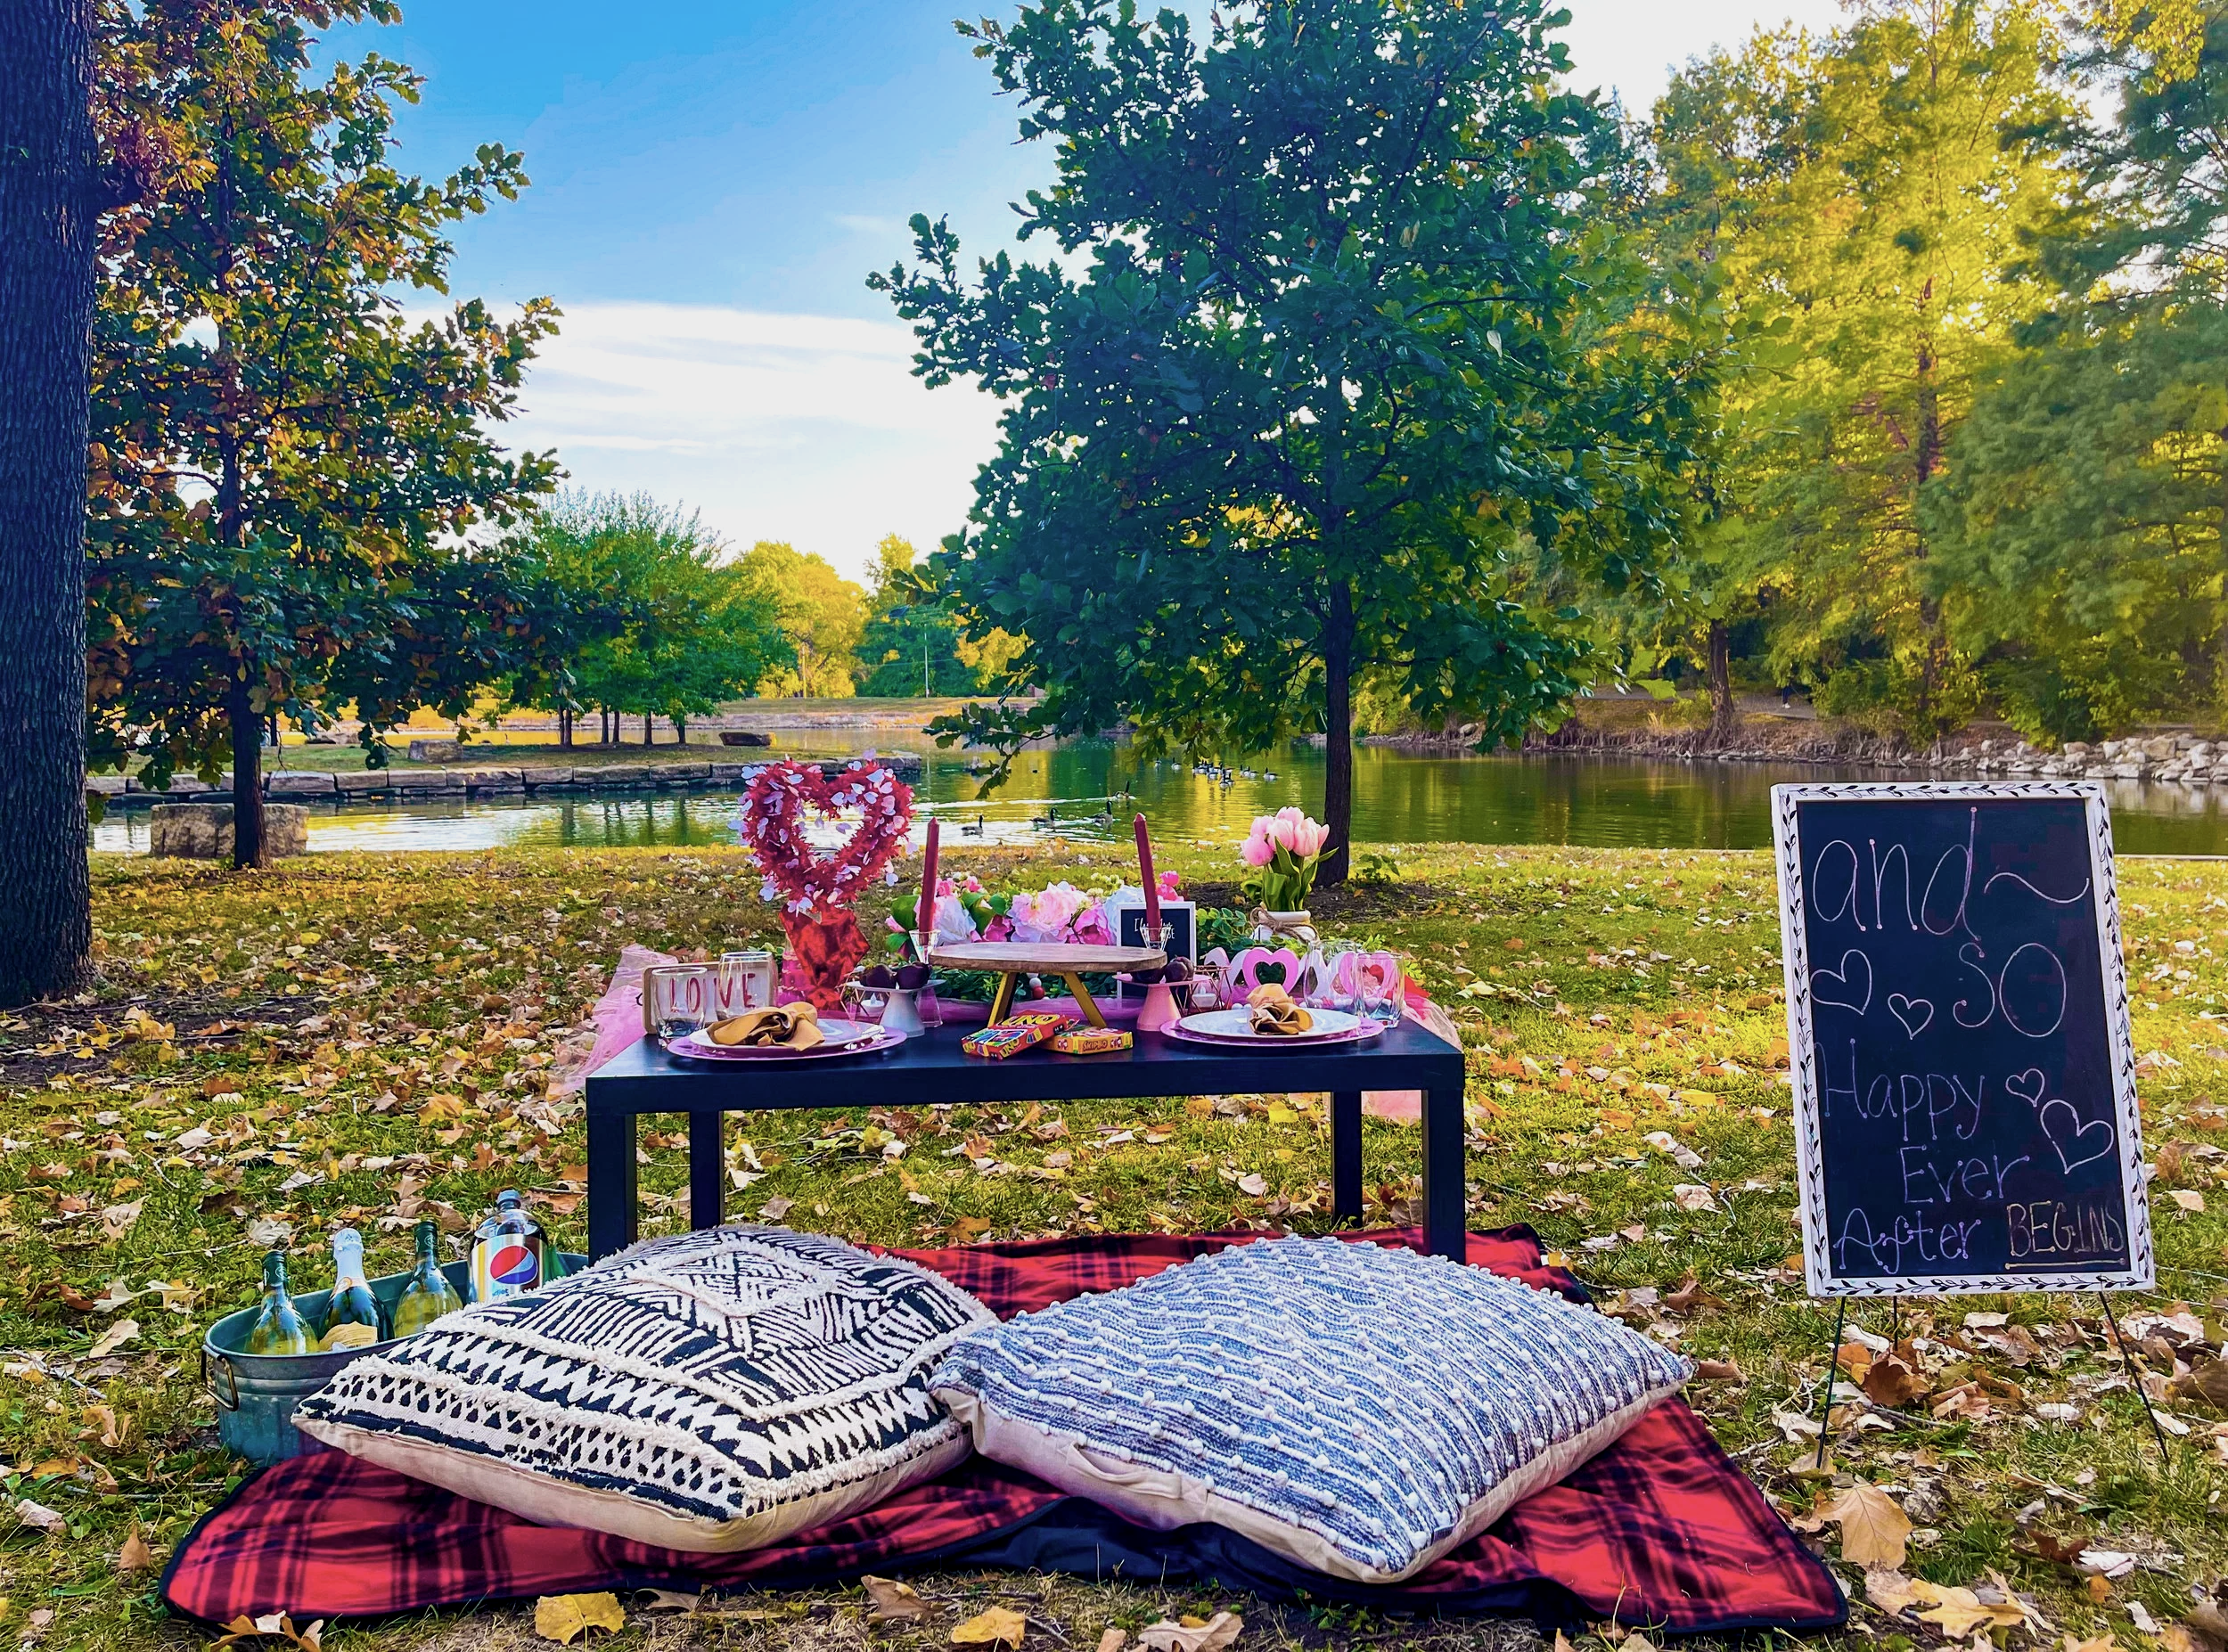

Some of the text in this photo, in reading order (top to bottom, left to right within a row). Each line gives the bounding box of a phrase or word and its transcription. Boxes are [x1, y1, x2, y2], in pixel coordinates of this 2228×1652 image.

[1813, 806, 1982, 941] and
[669, 972, 756, 1014] LOVE
[996, 1014, 1060, 1026] UNO
[1000, 1039, 1020, 1058] UNO
[1813, 1037, 1986, 1141] Happy
[1899, 1144, 2031, 1203] Ever
[1832, 1200, 2126, 1275] After BEGINS
